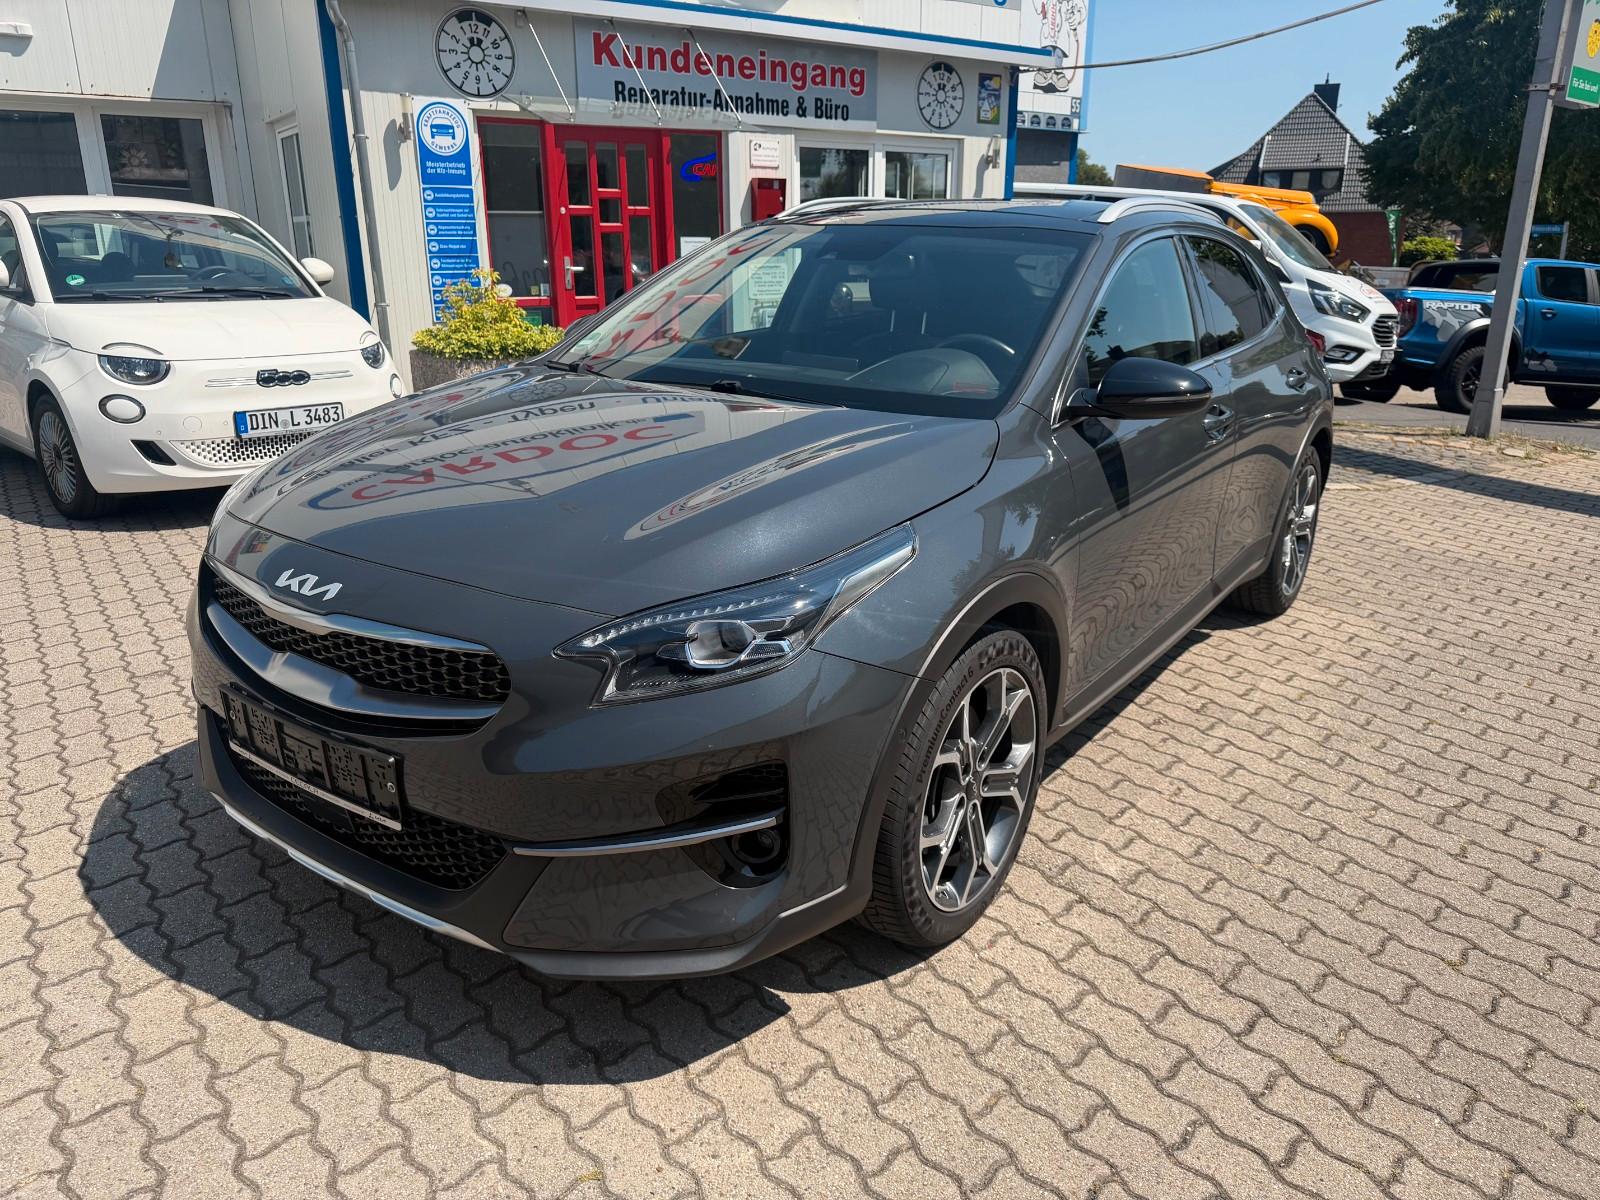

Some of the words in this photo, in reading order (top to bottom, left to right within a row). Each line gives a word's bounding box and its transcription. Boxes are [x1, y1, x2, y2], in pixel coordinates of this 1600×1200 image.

[469, 23, 479, 34] 12
[592, 31, 866, 97] Kundeneingang
[614, 80, 789, 117] Reparatur-Annahme
[796, 96, 807, 118] &
[814, 97, 849, 121] Büro
[1425, 301, 1482, 312] RAPTOR
[256, 369, 311, 388] 500
[248, 411, 279, 430] DIN
[290, 410, 300, 427] L
[304, 405, 340, 425] 3483
[275, 568, 342, 601] KIA
